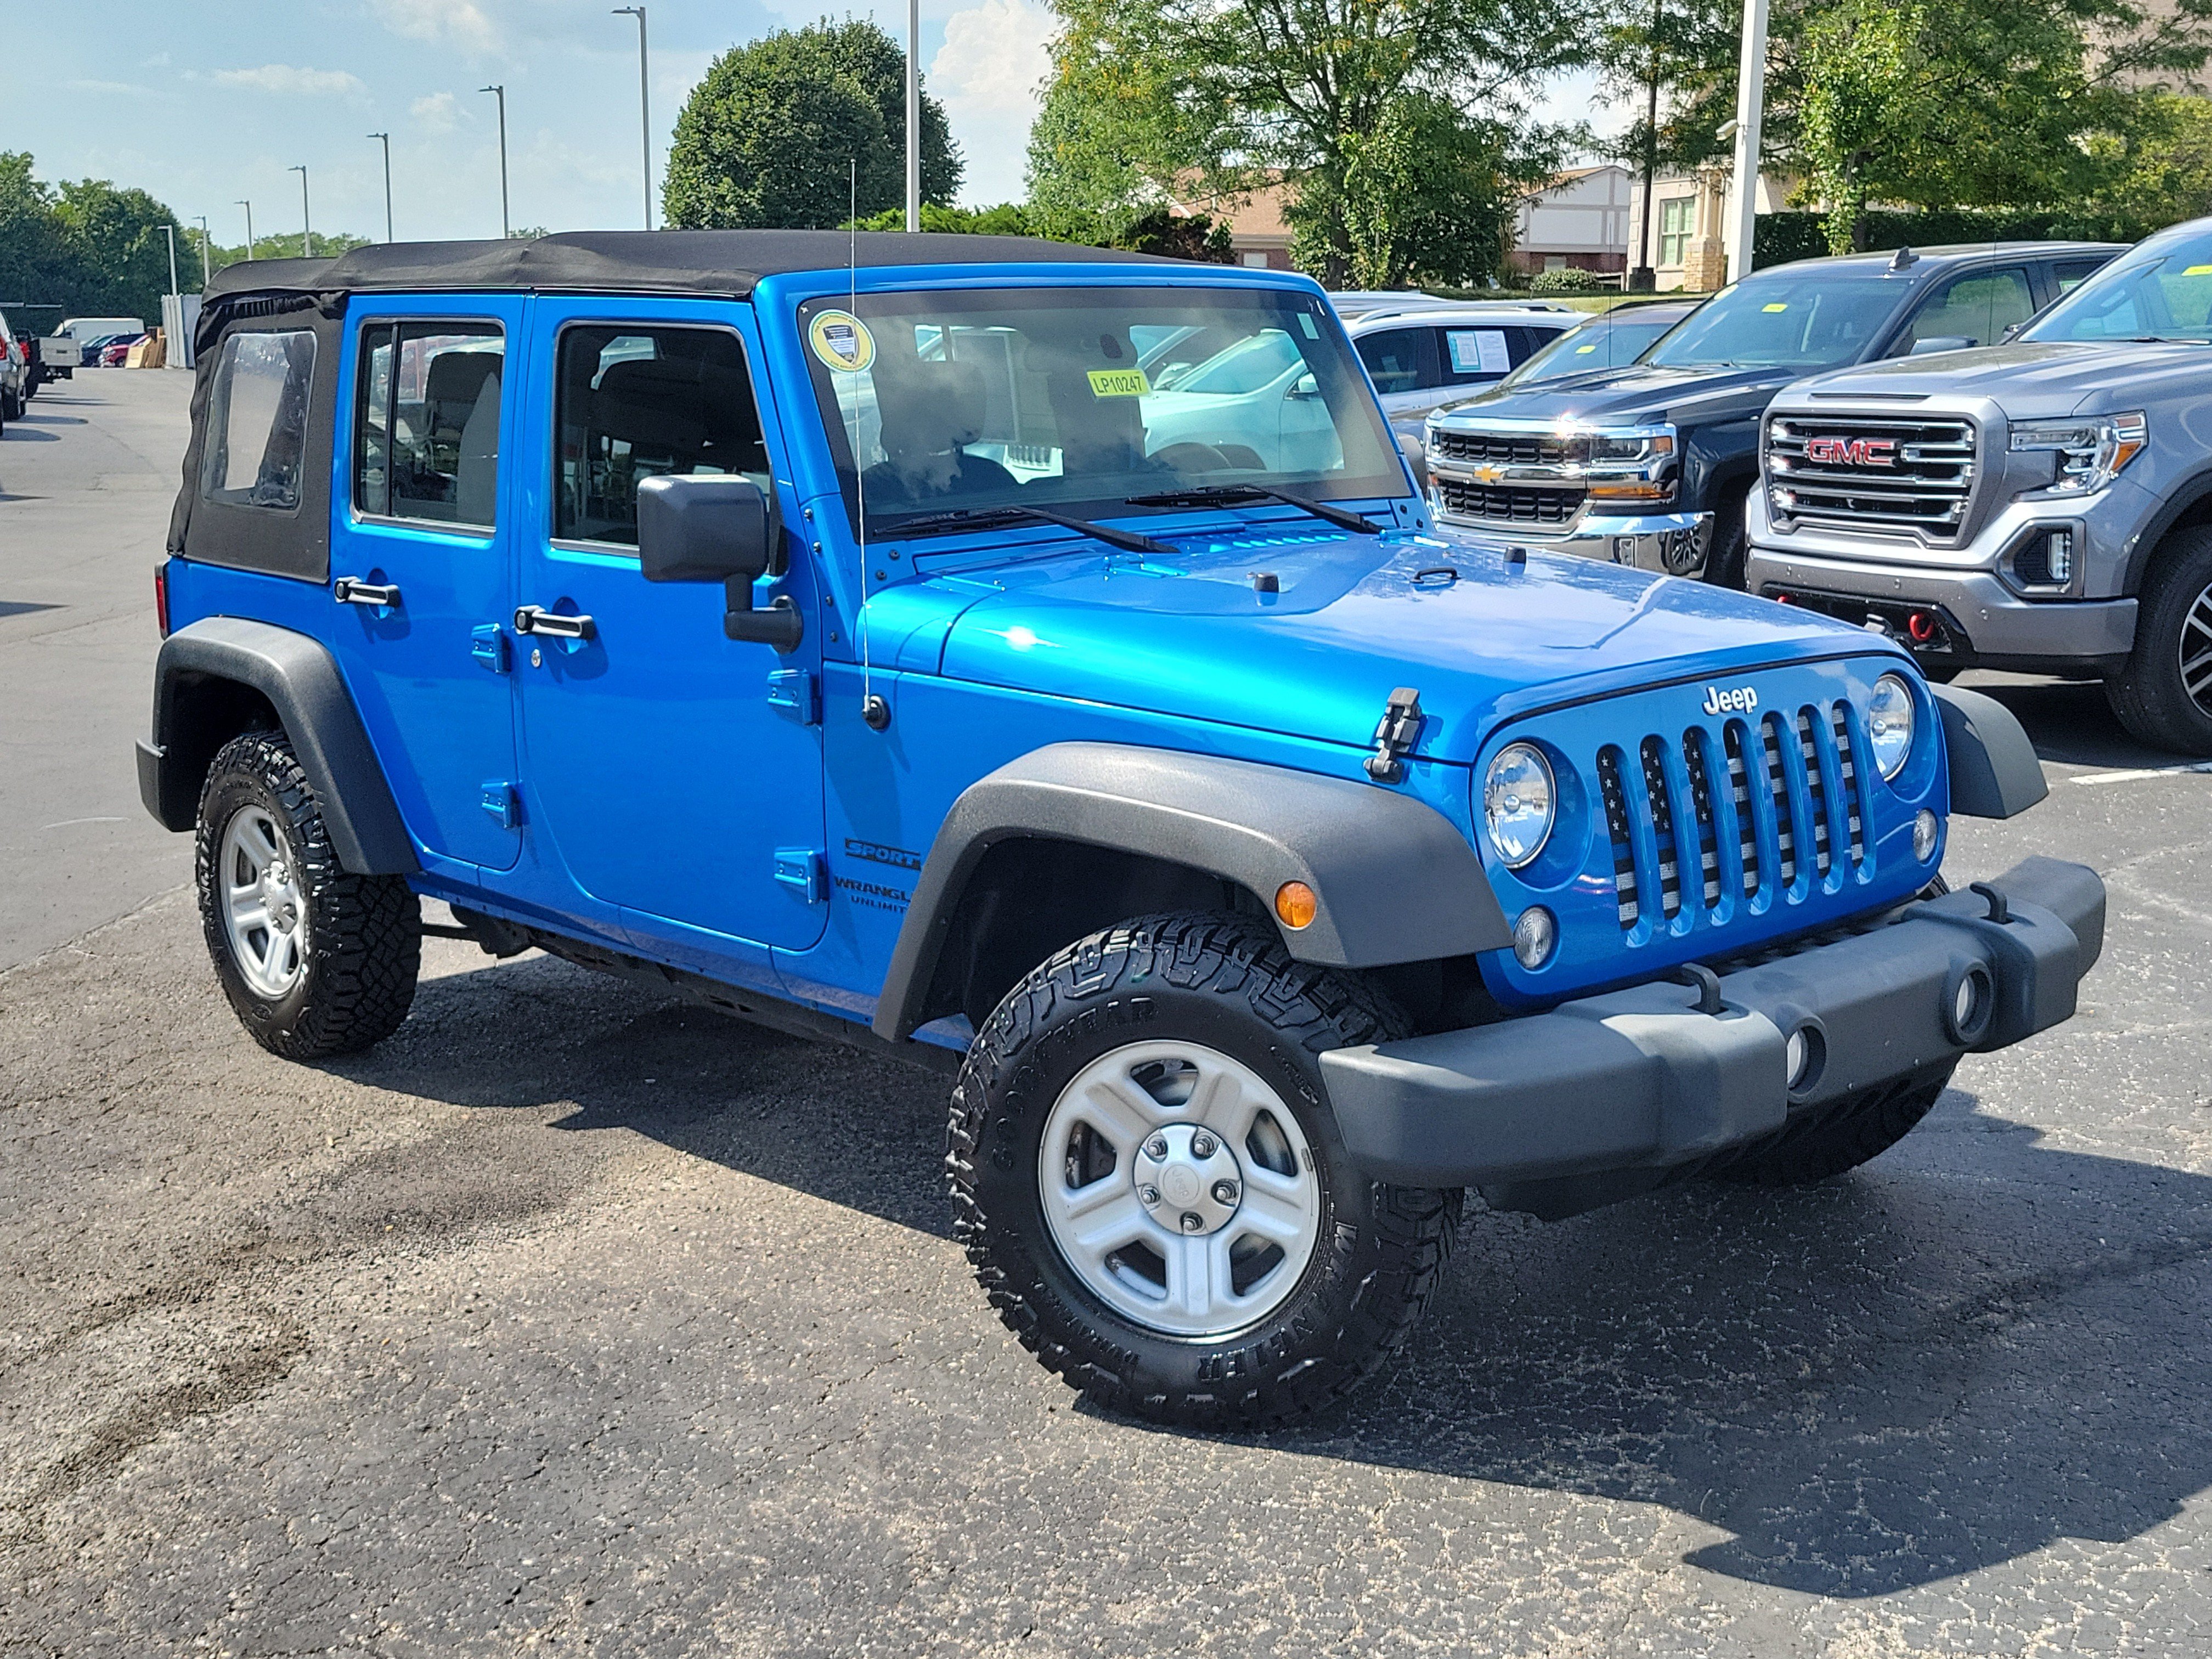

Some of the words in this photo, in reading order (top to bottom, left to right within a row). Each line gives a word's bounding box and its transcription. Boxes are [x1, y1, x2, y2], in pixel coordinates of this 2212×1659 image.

[1092, 376, 1142, 393] LP10247
[1808, 438, 1896, 467] GMC
[1702, 686, 1758, 716] Jeep
[846, 839, 921, 869] SPORT
[833, 875, 912, 903] WRANGL
[850, 895, 908, 915] UNLIMIT
